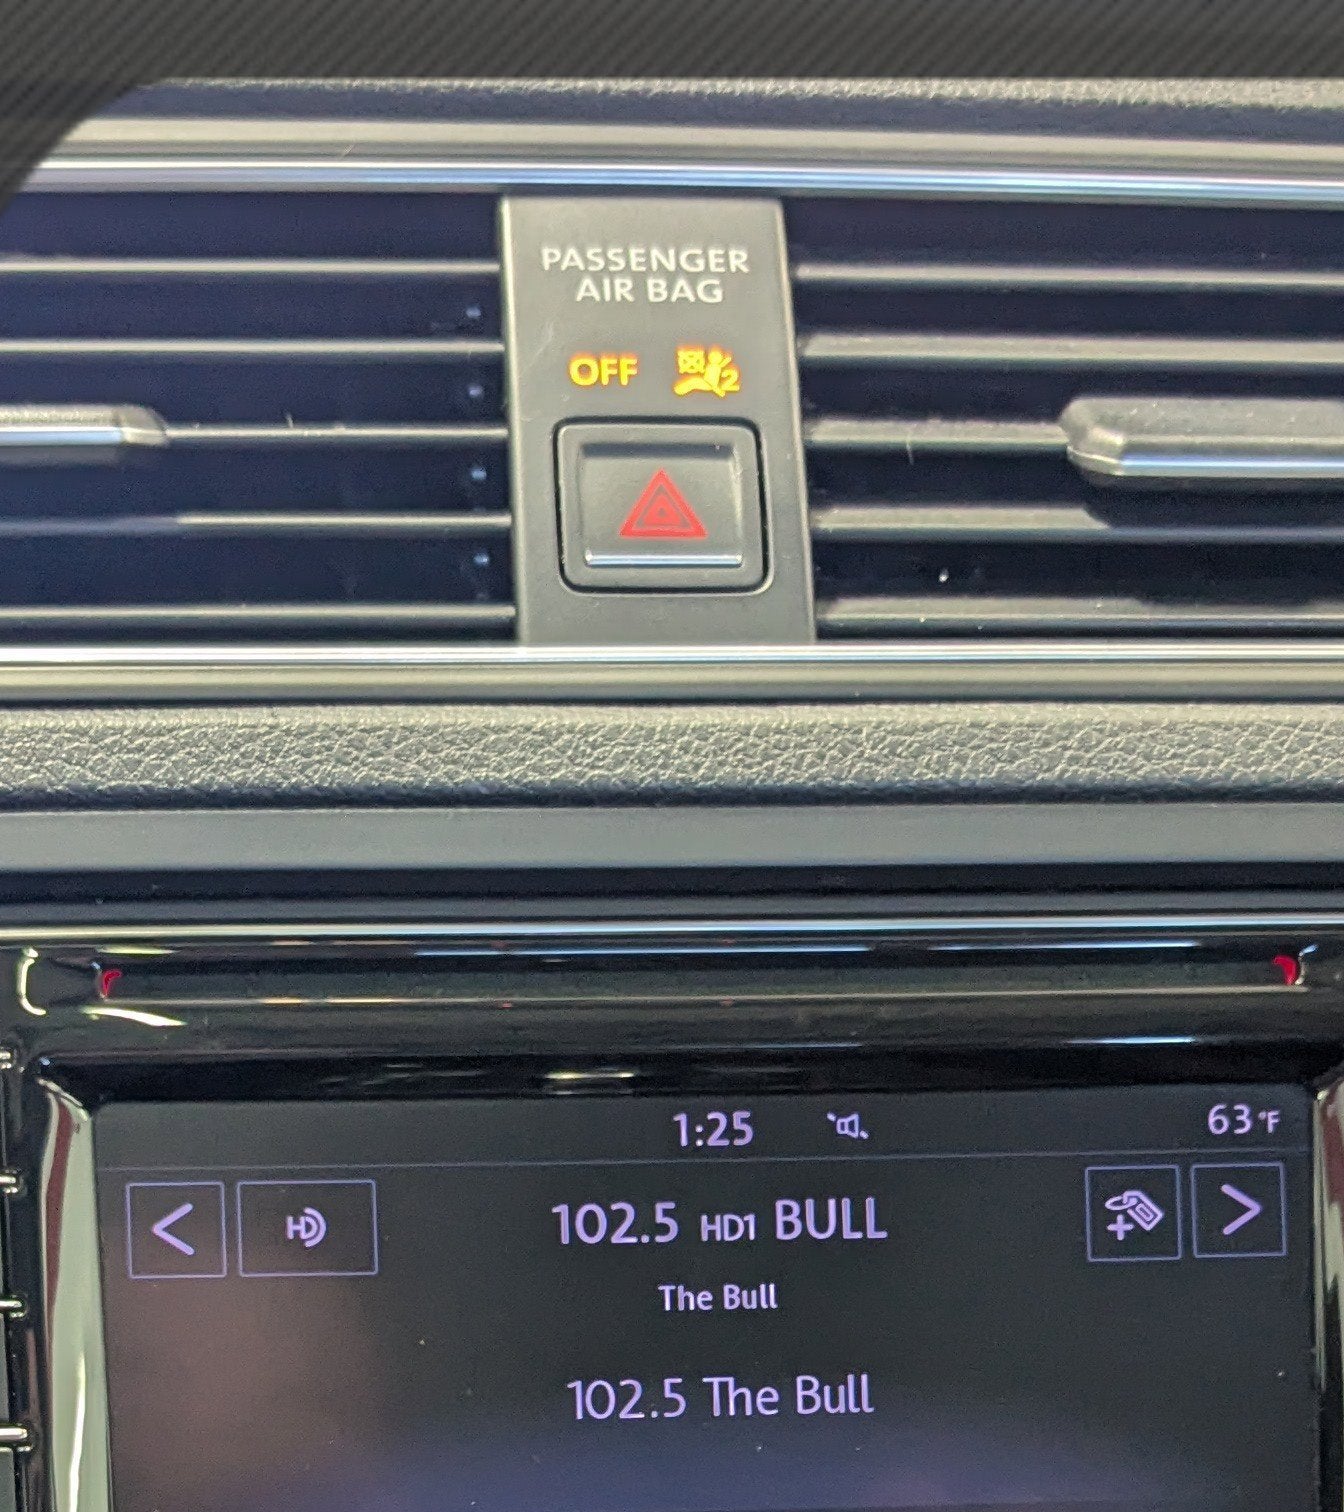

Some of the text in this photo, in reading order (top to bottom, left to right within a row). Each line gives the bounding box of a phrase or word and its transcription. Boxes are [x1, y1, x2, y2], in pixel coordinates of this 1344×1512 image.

[541, 246, 750, 274] PASSENGER
[574, 277, 725, 305] AIR BAG
[568, 355, 638, 386] OFF
[672, 1110, 754, 1147] 1:25
[551, 1196, 888, 1245] 102.5 HD1 BULL
[657, 1282, 778, 1312] The Bull
[566, 1373, 875, 1420] 102.5 The Bull
